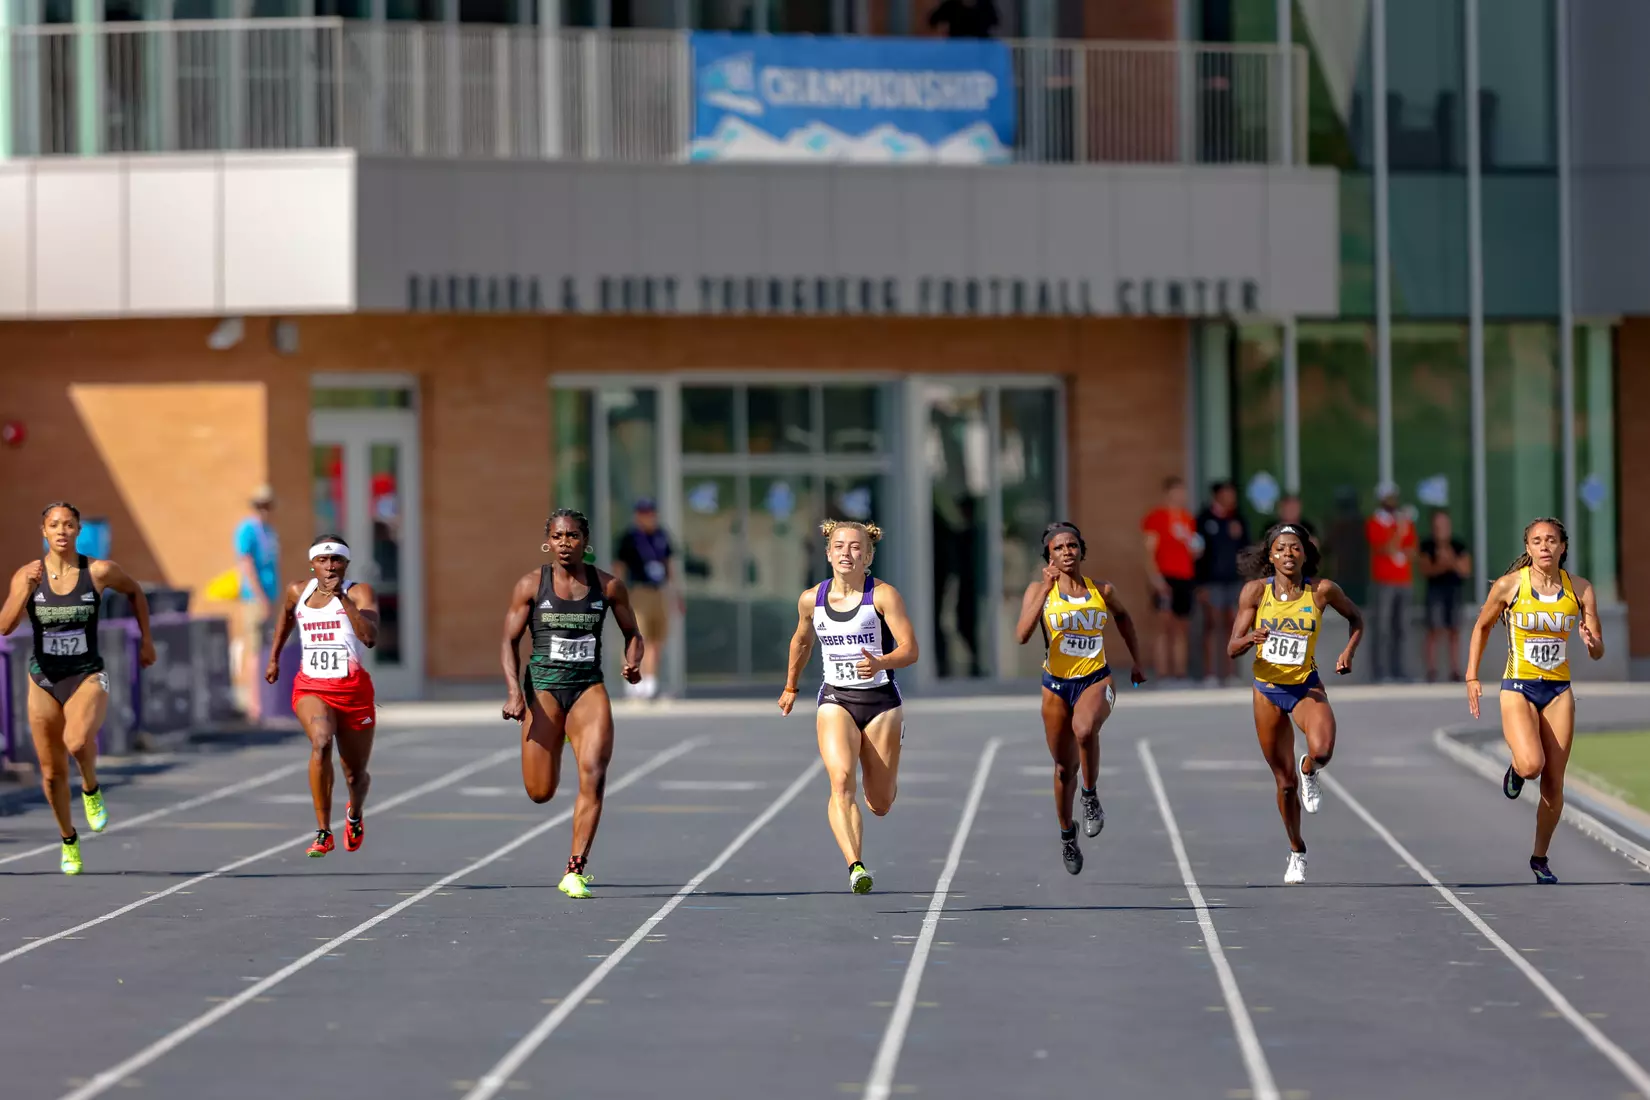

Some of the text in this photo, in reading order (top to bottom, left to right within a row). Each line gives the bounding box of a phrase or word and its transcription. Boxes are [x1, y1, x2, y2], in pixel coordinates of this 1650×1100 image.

[762, 67, 998, 110] CHAMPIONSHIP
[919, 277, 1091, 315] FOOTBALL
[1115, 278, 1260, 315] CENTER
[541, 613, 600, 622] SACRAMENTO
[1048, 609, 1108, 631] UNC
[1260, 617, 1316, 632] NAU
[1515, 611, 1576, 632] UNC
[50, 637, 81, 654] 452
[311, 632, 335, 642] UTAH
[846, 632, 875, 645] STATE
[1268, 636, 1300, 659] 364
[1530, 643, 1561, 663] 402
[310, 651, 339, 670] 491
[835, 662, 862, 680] 53
